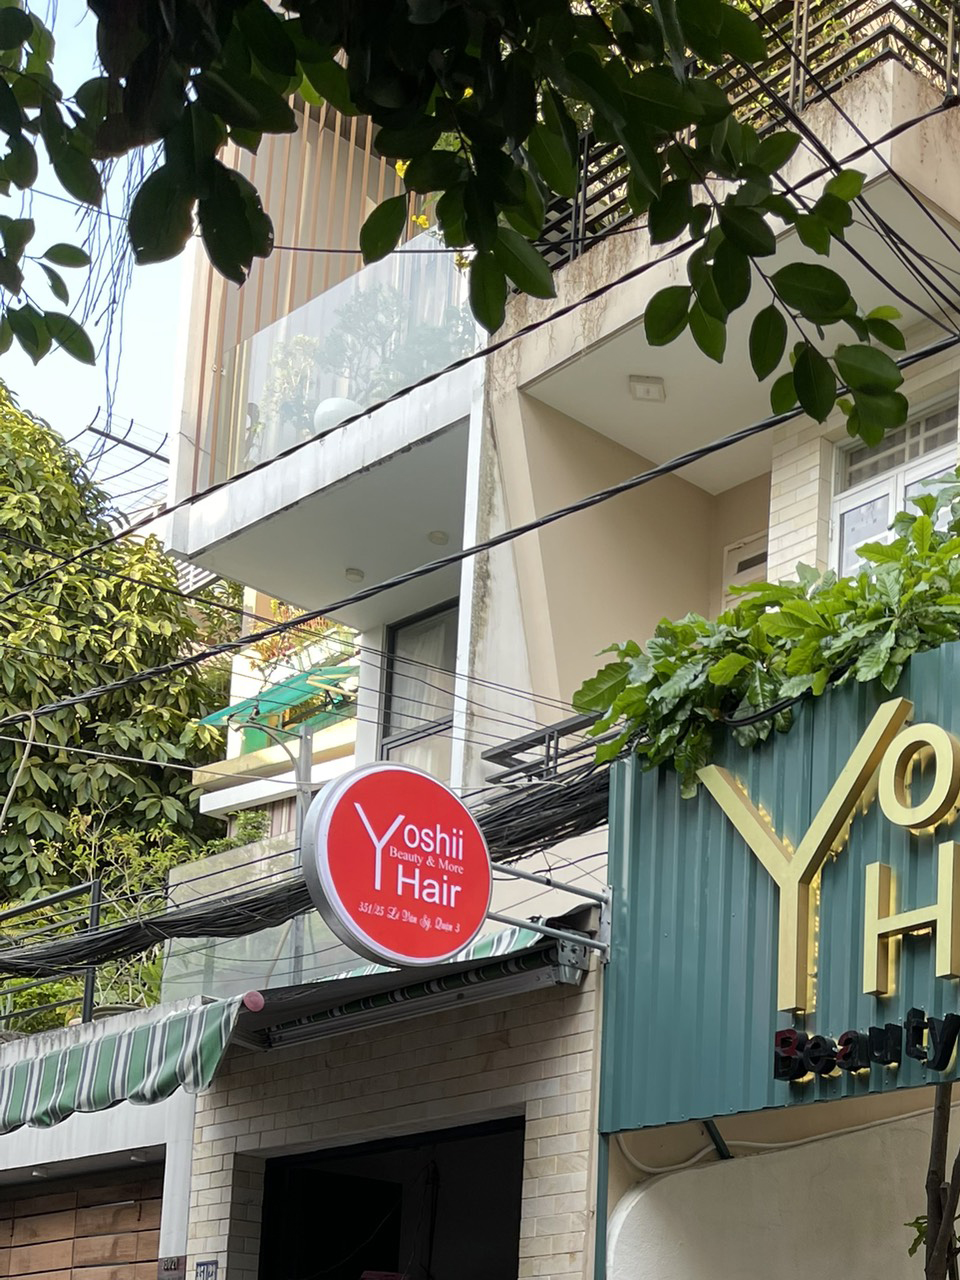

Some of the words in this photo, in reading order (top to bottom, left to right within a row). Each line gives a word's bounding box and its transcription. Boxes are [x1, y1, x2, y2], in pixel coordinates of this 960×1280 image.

[354, 802, 463, 891] Yoshii
[389, 846, 423, 866] Beauty
[426, 855, 436, 867] &
[438, 859, 464, 875] More
[396, 863, 463, 908] Hair
